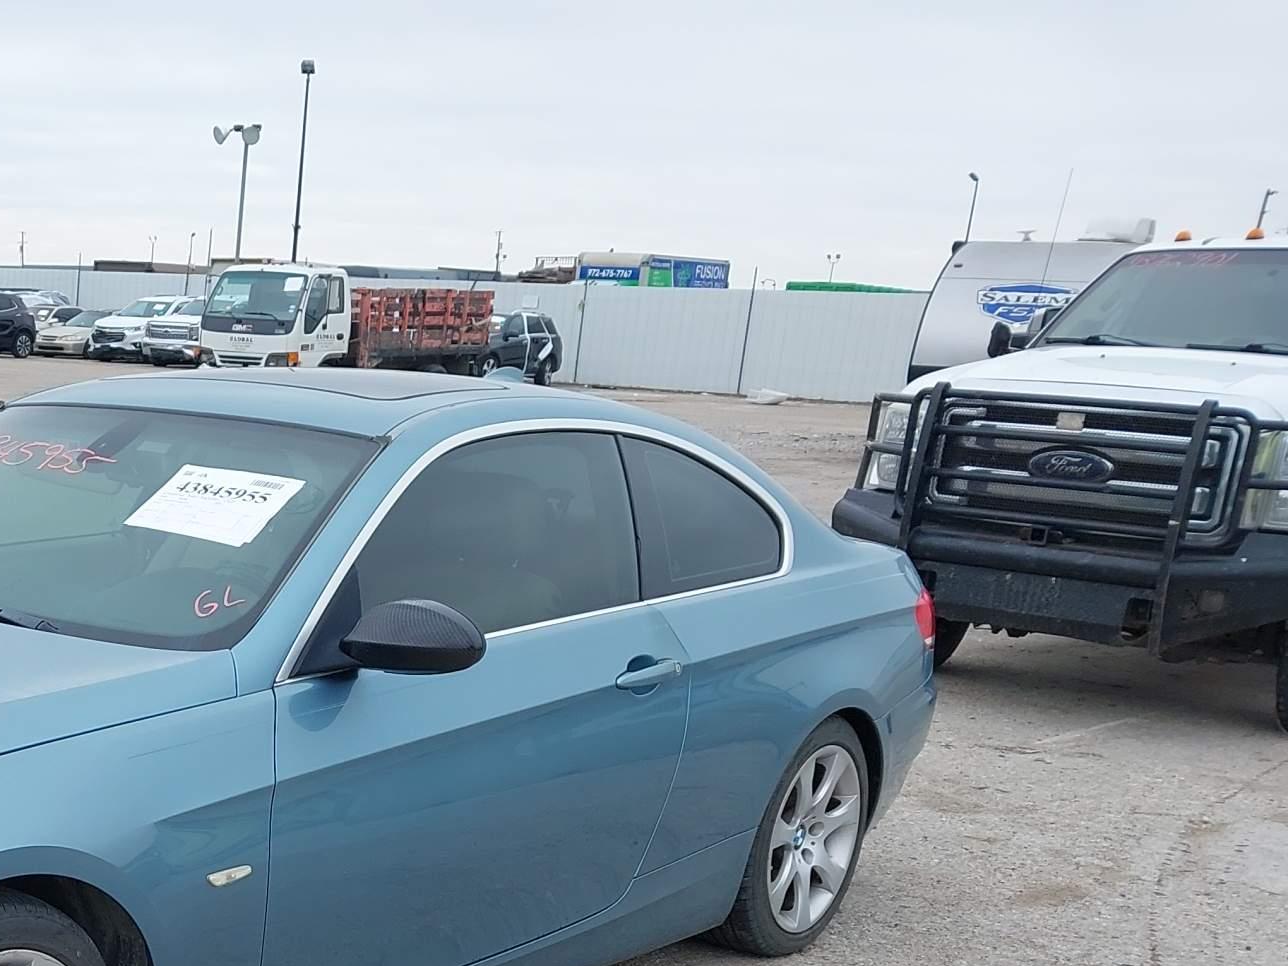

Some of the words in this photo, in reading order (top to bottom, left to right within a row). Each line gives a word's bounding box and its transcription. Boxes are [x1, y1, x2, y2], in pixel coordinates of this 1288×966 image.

[695, 264, 726, 280] FUSION
[982, 292, 1070, 305] SALEM
[1045, 456, 1092, 475] Ford
[176, 481, 272, 504] 43845955
